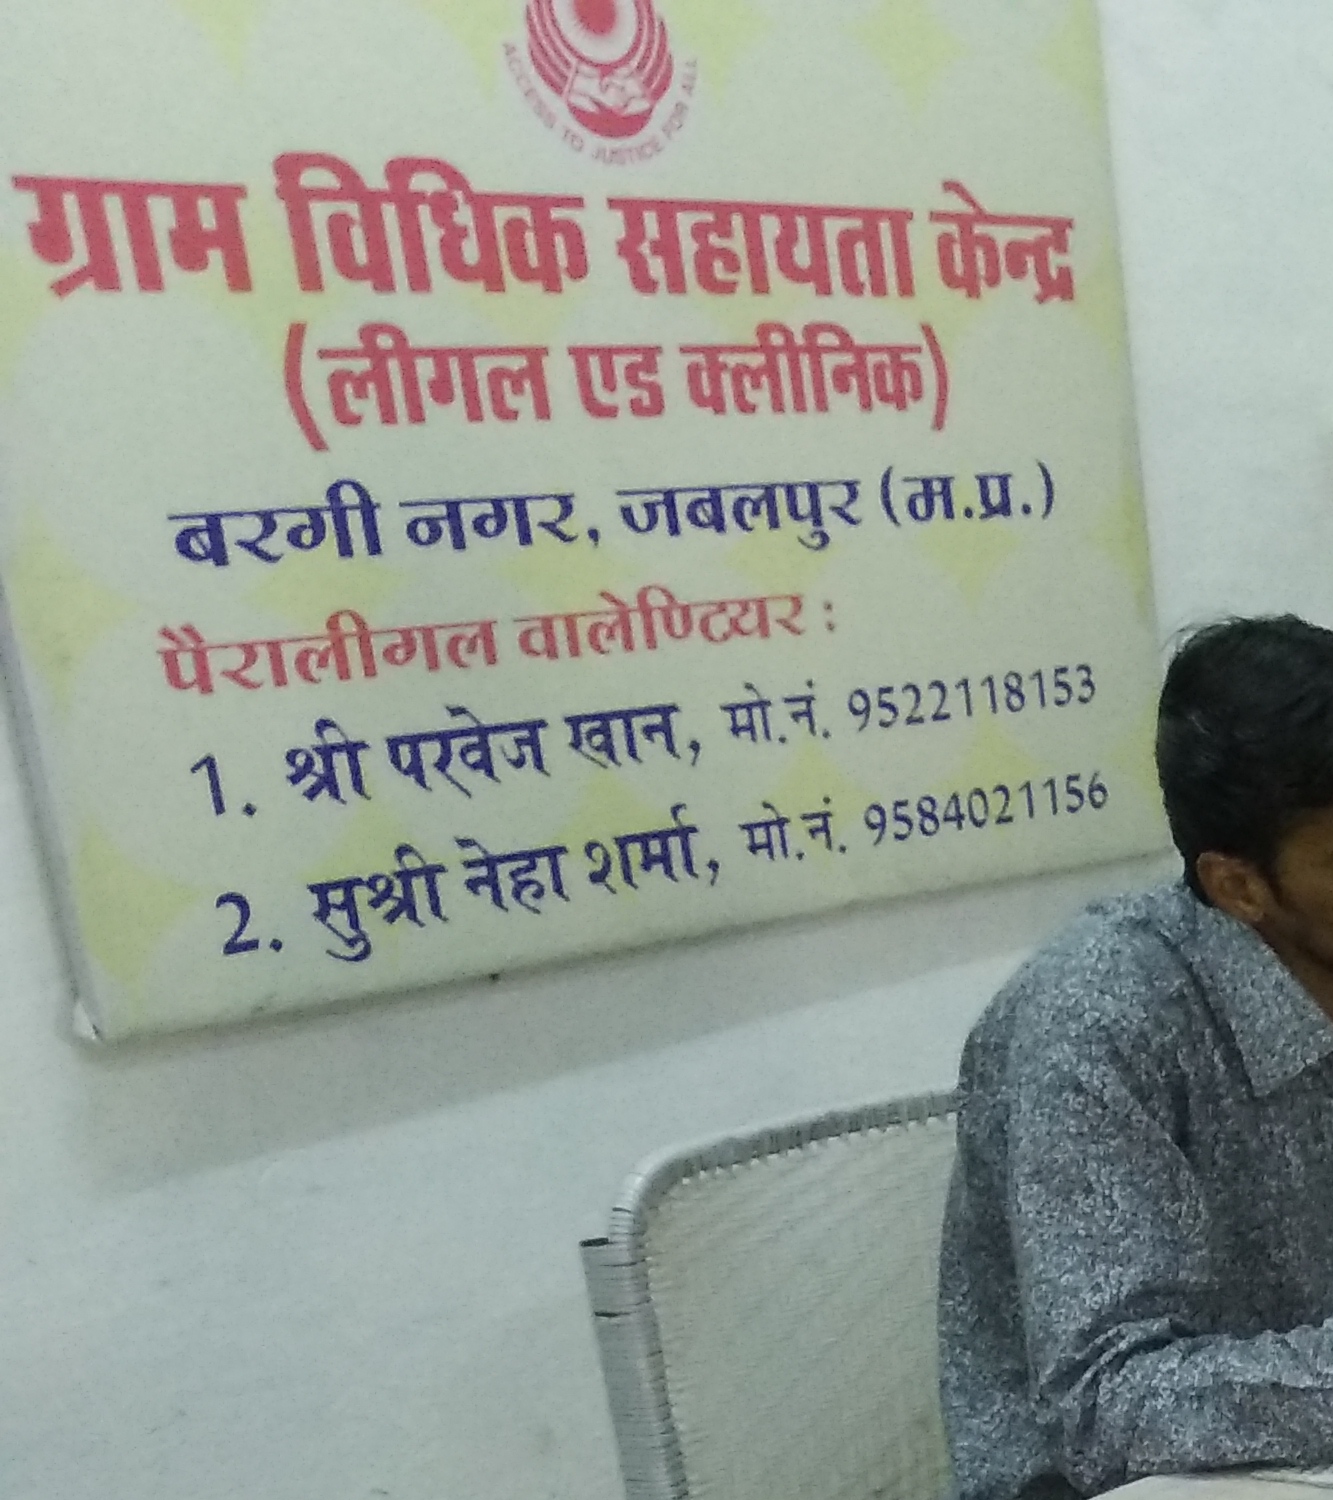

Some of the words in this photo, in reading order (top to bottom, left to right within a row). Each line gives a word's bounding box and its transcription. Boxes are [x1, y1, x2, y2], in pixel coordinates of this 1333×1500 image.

[562, 126, 585, 151] TO
[661, 101, 689, 141] FOR
[11, 174, 253, 299] ग्राम
[272, 150, 589, 294] विधिक
[606, 196, 916, 298] सहायता
[929, 178, 1076, 304] केन्द्र
[282, 321, 552, 452] (लीगल
[566, 344, 666, 420] एड
[678, 321, 950, 432] क्लीनिक)
[166, 477, 384, 568] बरगी
[398, 492, 600, 552] नगर,
[615, 478, 862, 551] जबलपुर
[879, 458, 1057, 527] (म.प्र.)
[155, 609, 499, 695] पैरालीगल
[189, 754, 258, 819] 1.
[284, 717, 372, 806] श्री
[385, 705, 552, 799] परवेज
[563, 702, 702, 771] खान,
[846, 662, 1097, 733] 9522118153
[214, 891, 284, 957] 2.
[306, 841, 450, 964] सुश्री
[453, 835, 571, 915] नेहा
[584, 802, 721, 895] शर्मा,
[862, 771, 1110, 848] 9584021156
